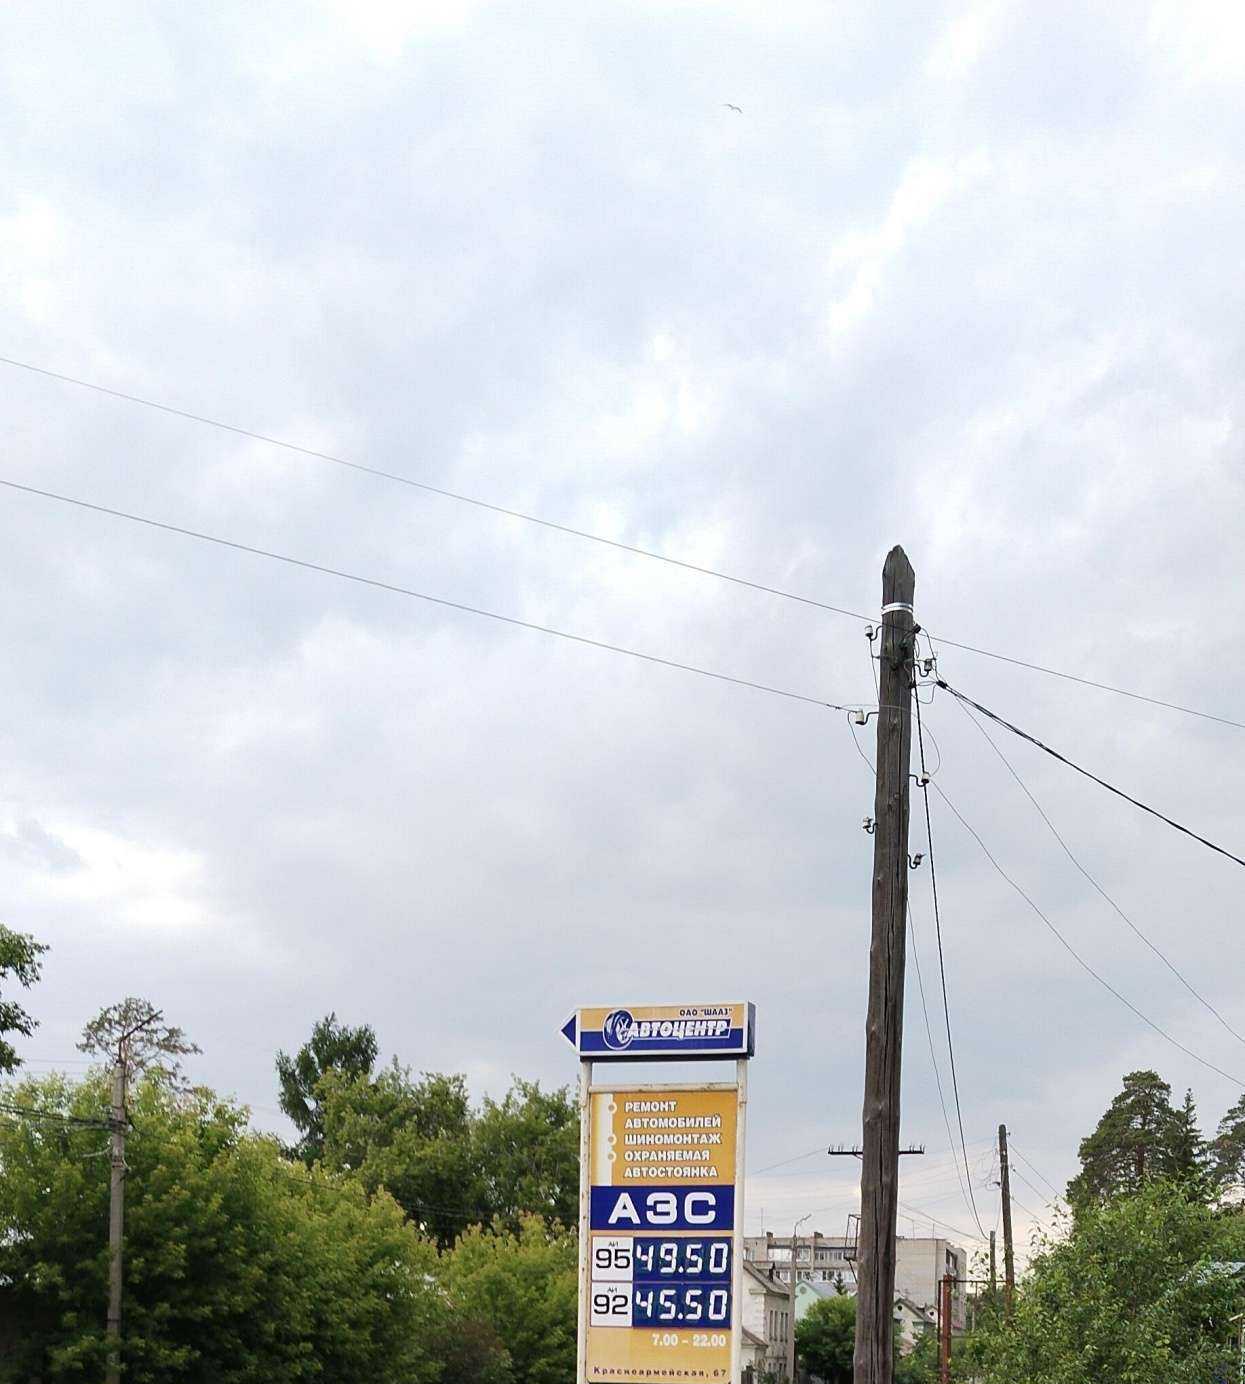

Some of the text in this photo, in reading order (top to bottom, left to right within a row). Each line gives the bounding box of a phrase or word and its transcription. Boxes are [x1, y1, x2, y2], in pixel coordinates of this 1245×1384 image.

[679, 1009, 698, 1017] ОАО
[627, 1020, 728, 1039] АВТОЦЕНТР
[624, 1101, 677, 1112] РЕМОНТ
[624, 1114, 721, 1129] АВТОМОБИЛЕЙ
[624, 1133, 722, 1145] ШИНОМОНТАЖ
[624, 1150, 710, 1161] ОХРАНЯЕМАЯ
[623, 1166, 718, 1178] АВТОСТОЯНКА
[608, 1192, 716, 1224] АЗС
[596, 1243, 728, 1273] 95 49.50
[593, 1289, 728, 1320] 92 45.50
[652, 1333, 678, 1345] 7.00
[693, 1334, 726, 1347] 22.00
[713, 1369, 727, 1377] 67
